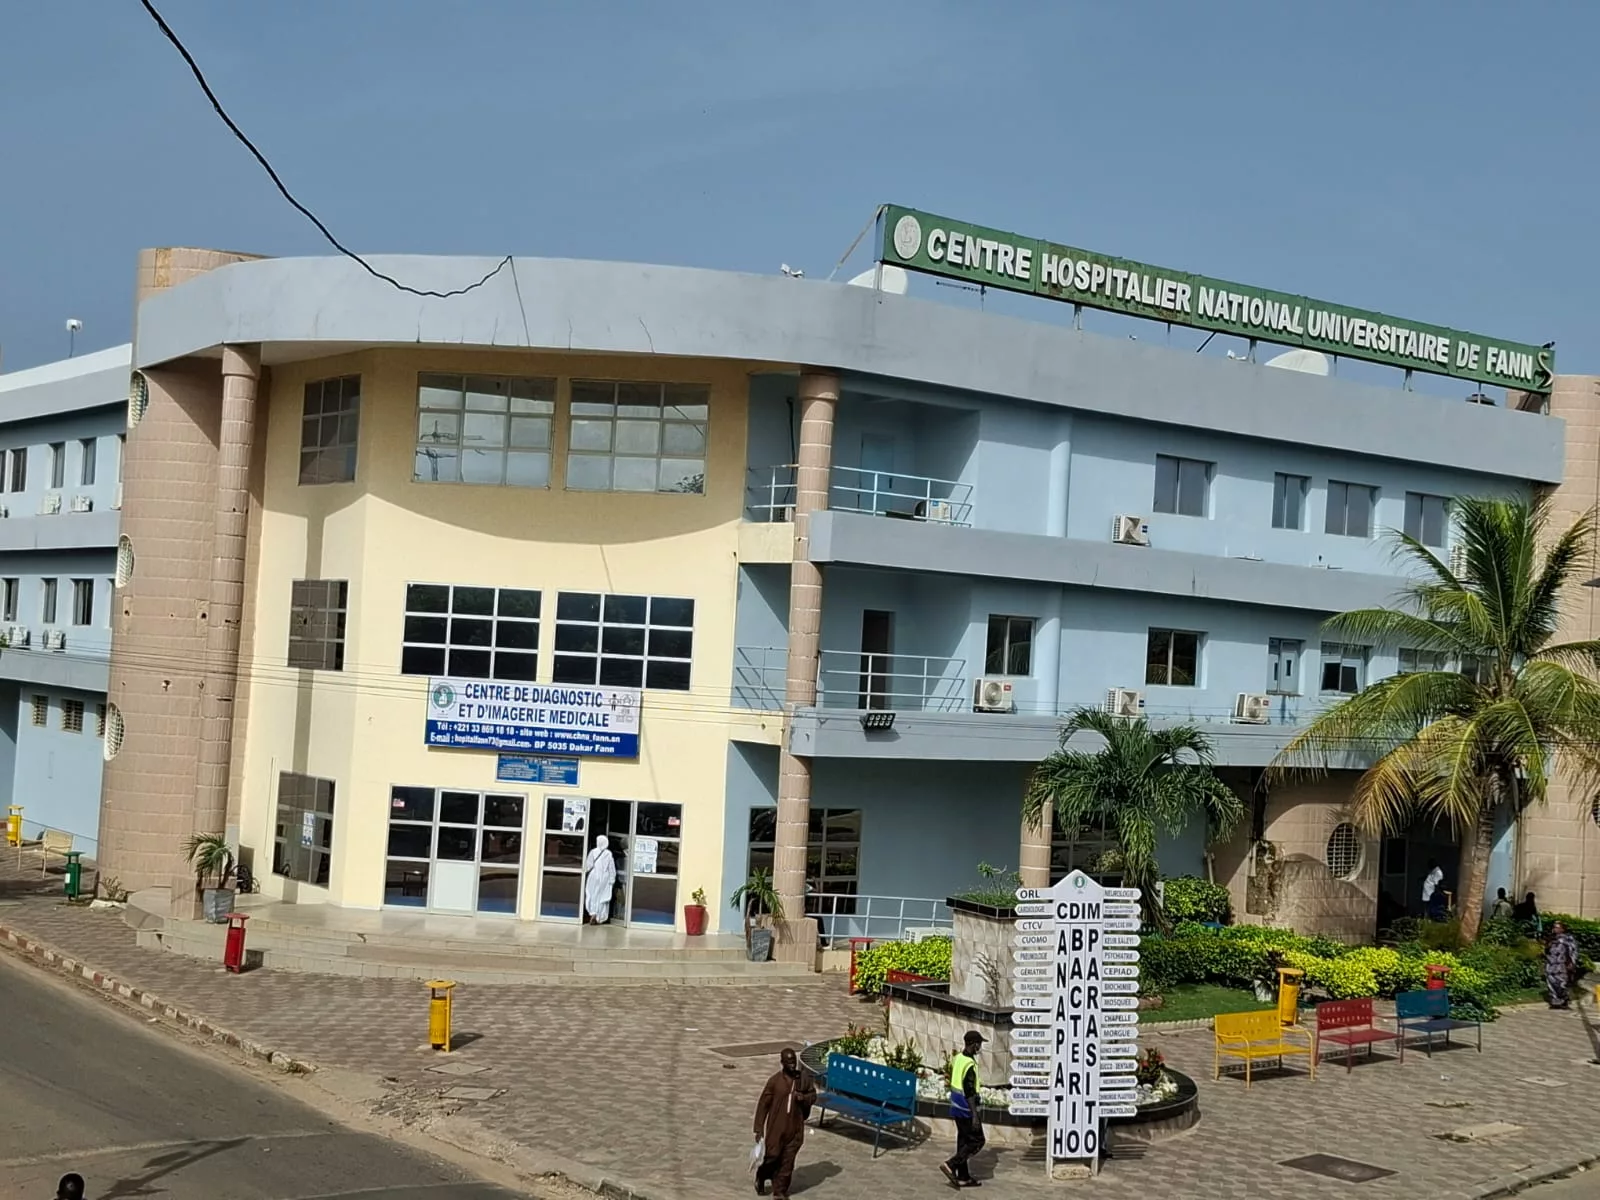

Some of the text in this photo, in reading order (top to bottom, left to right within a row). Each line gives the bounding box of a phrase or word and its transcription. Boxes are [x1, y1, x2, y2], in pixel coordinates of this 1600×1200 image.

[927, 228, 1534, 380] CENTRE HOSPITALIER NATIONAL UNIVERSITAIRE DE FANN
[465, 683, 603, 707] CENTRE DE DIAGNOSTIC
[458, 703, 474, 718] ET
[477, 704, 546, 723] D'IMAGERIE
[549, 710, 610, 727] MEDICALE
[453, 723, 470, 732] +221
[471, 724, 480, 732] 33
[519, 728, 532, 736] site
[534, 729, 548, 738] web
[534, 740, 546, 749] BP
[547, 741, 567, 750] 5035
[569, 742, 593, 752] Dakar
[595, 744, 615, 753] Fann
[1020, 889, 1040, 899] ORL
[1056, 902, 1100, 919] CDIM
[1022, 921, 1043, 930] CTCV
[1021, 936, 1048, 944] CUOMO
[1103, 967, 1132, 976] CEPIAD
[1020, 998, 1036, 1007] CTE
[1019, 1014, 1041, 1023] SMIT
[1104, 1014, 1131, 1022] CHAPELLE
[1103, 1029, 1131, 1037] MORGUE
[1053, 930, 1067, 1155] ANAPATH
[1066, 929, 1084, 1153] BACTERIO
[1084, 929, 1099, 1153] PARASITO
[1013, 1077, 1049, 1086] MAINTENANCE
